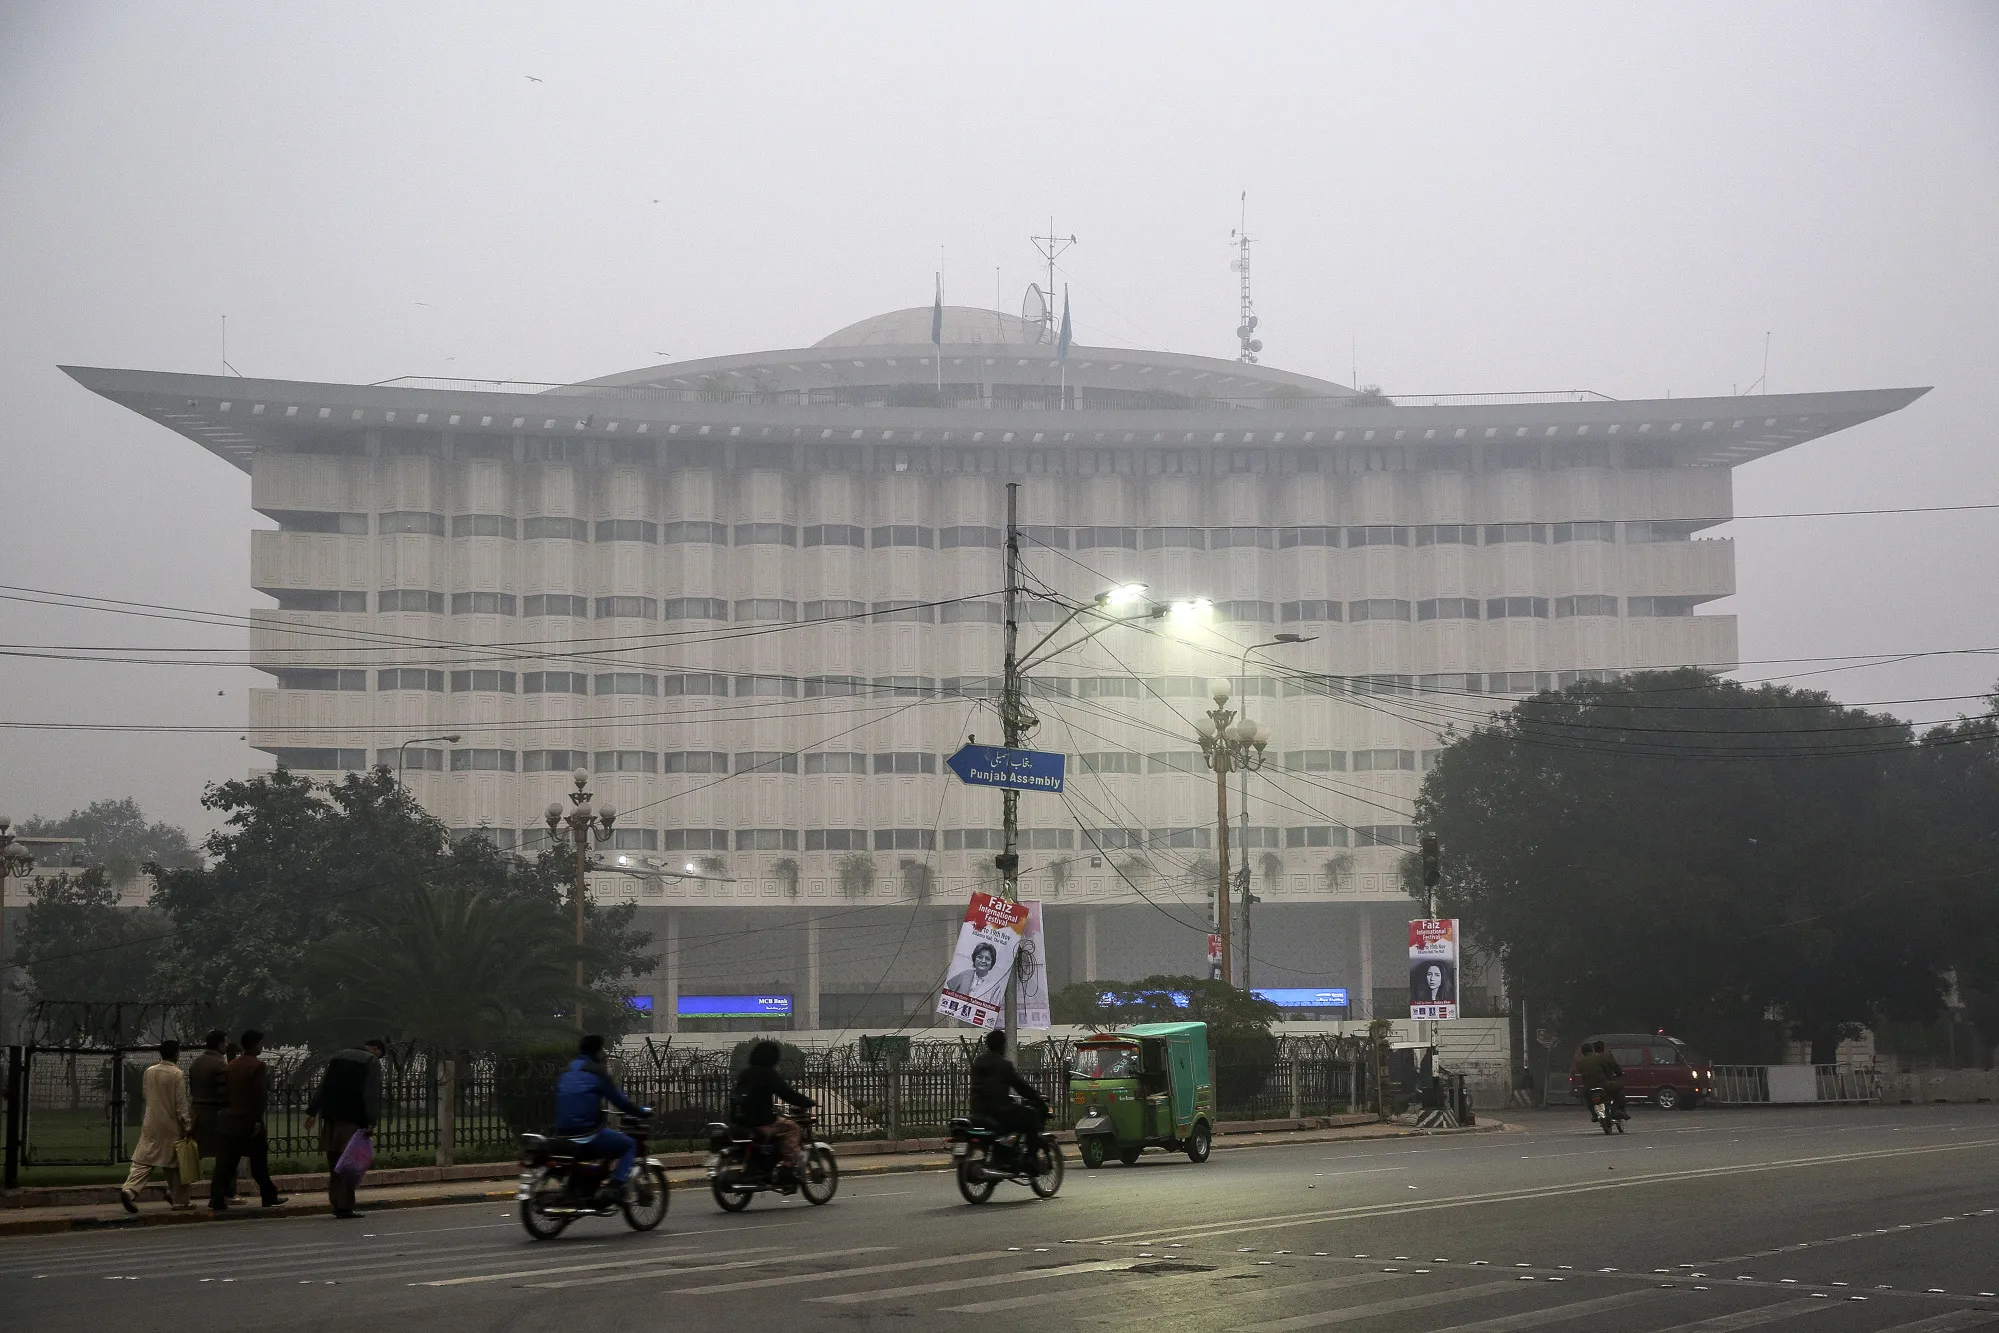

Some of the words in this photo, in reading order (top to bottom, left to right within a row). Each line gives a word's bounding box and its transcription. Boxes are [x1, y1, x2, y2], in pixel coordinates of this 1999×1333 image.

[970, 768, 1007, 782] Punjab
[1009, 772, 1061, 789] Assembly
[988, 896, 1013, 914] Faiz
[979, 904, 1018, 923] International
[985, 914, 1008, 926] Festival
[1422, 921, 1440, 929] Faiz
[1001, 932, 1011, 941] Nov
